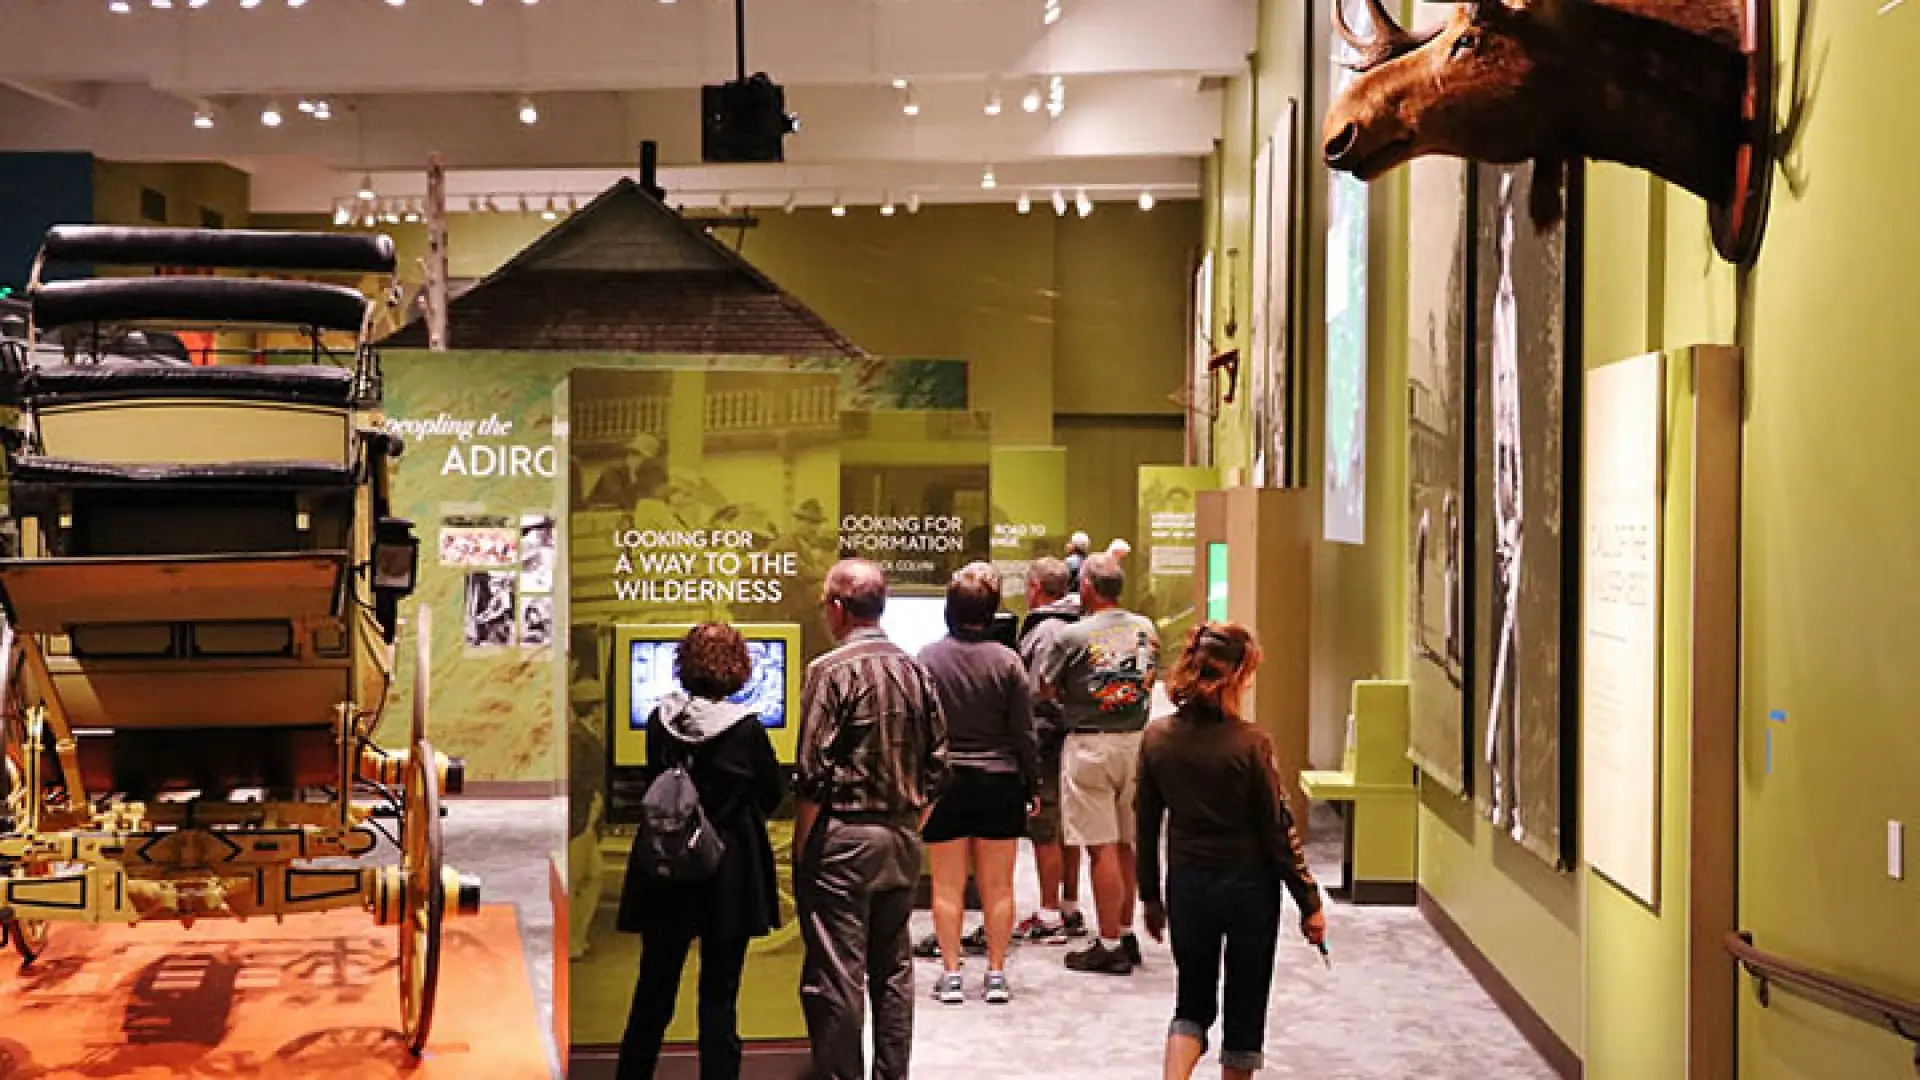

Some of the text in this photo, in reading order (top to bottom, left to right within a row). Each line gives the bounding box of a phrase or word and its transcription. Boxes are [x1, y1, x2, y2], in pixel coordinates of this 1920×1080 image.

[477, 413, 513, 436] the
[924, 515, 963, 533] FOR
[614, 529, 753, 548] LOOKING FOR
[614, 551, 798, 577] A WAY TO THE
[614, 578, 783, 604] WILDERNESS
